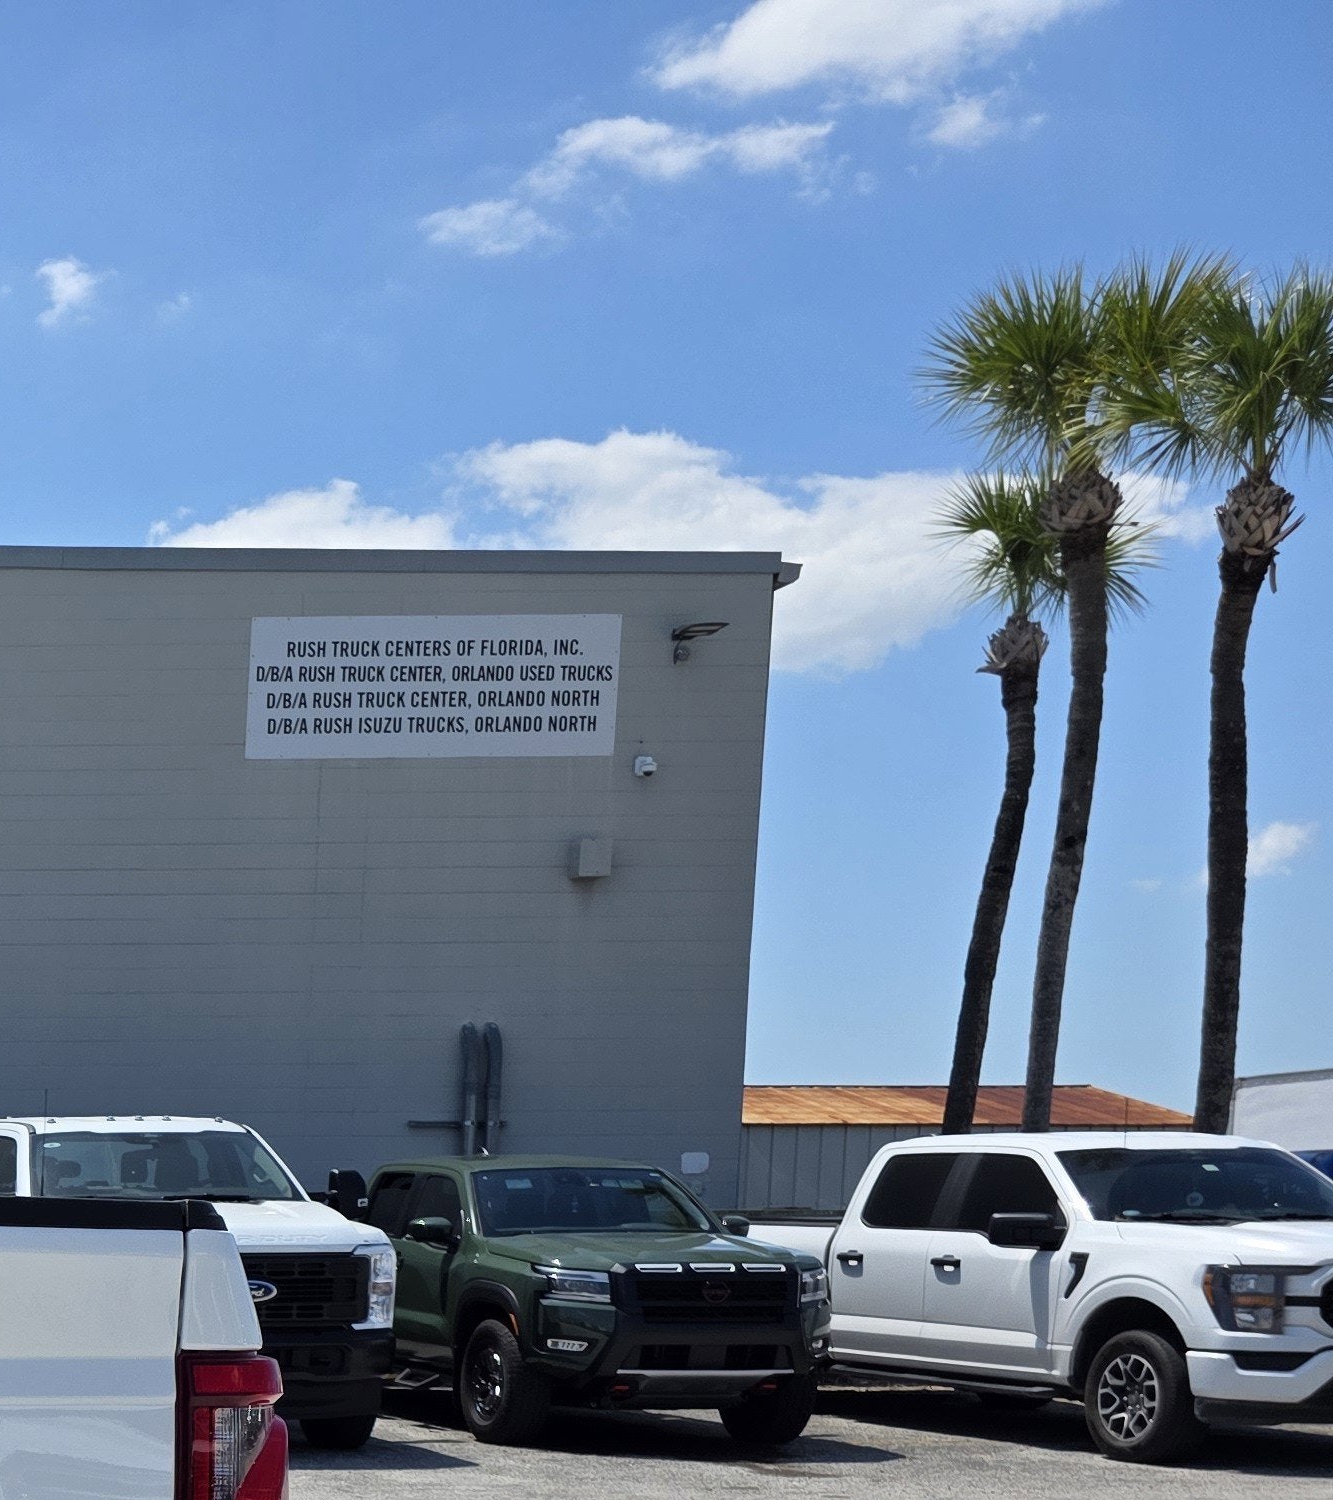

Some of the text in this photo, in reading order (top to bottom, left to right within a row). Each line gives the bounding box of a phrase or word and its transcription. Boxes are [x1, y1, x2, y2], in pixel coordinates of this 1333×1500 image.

[287, 639, 583, 657] RUSH TRUCK CENTERS OF FLORIDA, INC.
[257, 665, 612, 683] D/B/A RUSH TRUCK CENTER, ORLANDO USED TRUCKS
[267, 690, 599, 708] D/B/A RUSH TRUCK CENTER, ORLANDO NORTH
[268, 716, 596, 734] D/B/A RUSH ISUZU TRUCKS, ORLANDO NORTH
